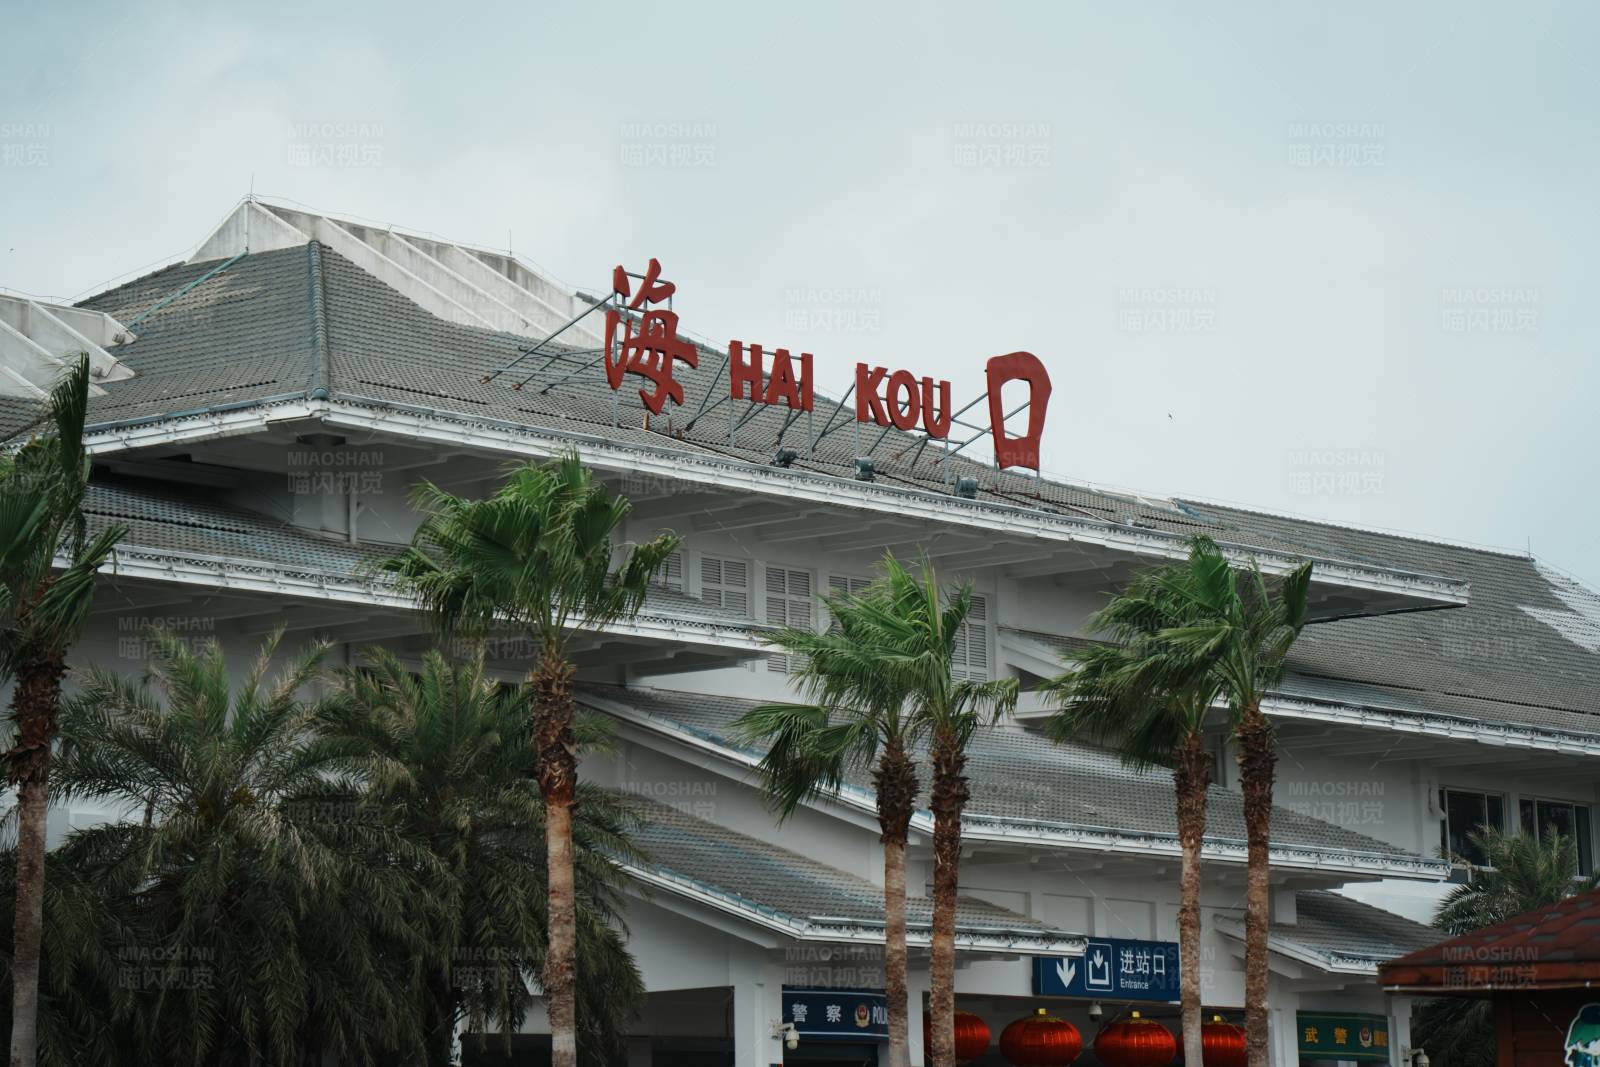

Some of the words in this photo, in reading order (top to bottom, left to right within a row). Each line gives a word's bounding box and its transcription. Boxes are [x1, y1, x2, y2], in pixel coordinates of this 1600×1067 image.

[606, 258, 698, 415] 海
[729, 340, 813, 411] HAI
[857, 363, 951, 438] KOU
[987, 351, 1052, 471] 口
[1120, 951, 1166, 976] 进站口
[1120, 978, 1149, 990] Entrance
[792, 1003, 842, 1024] 警察
